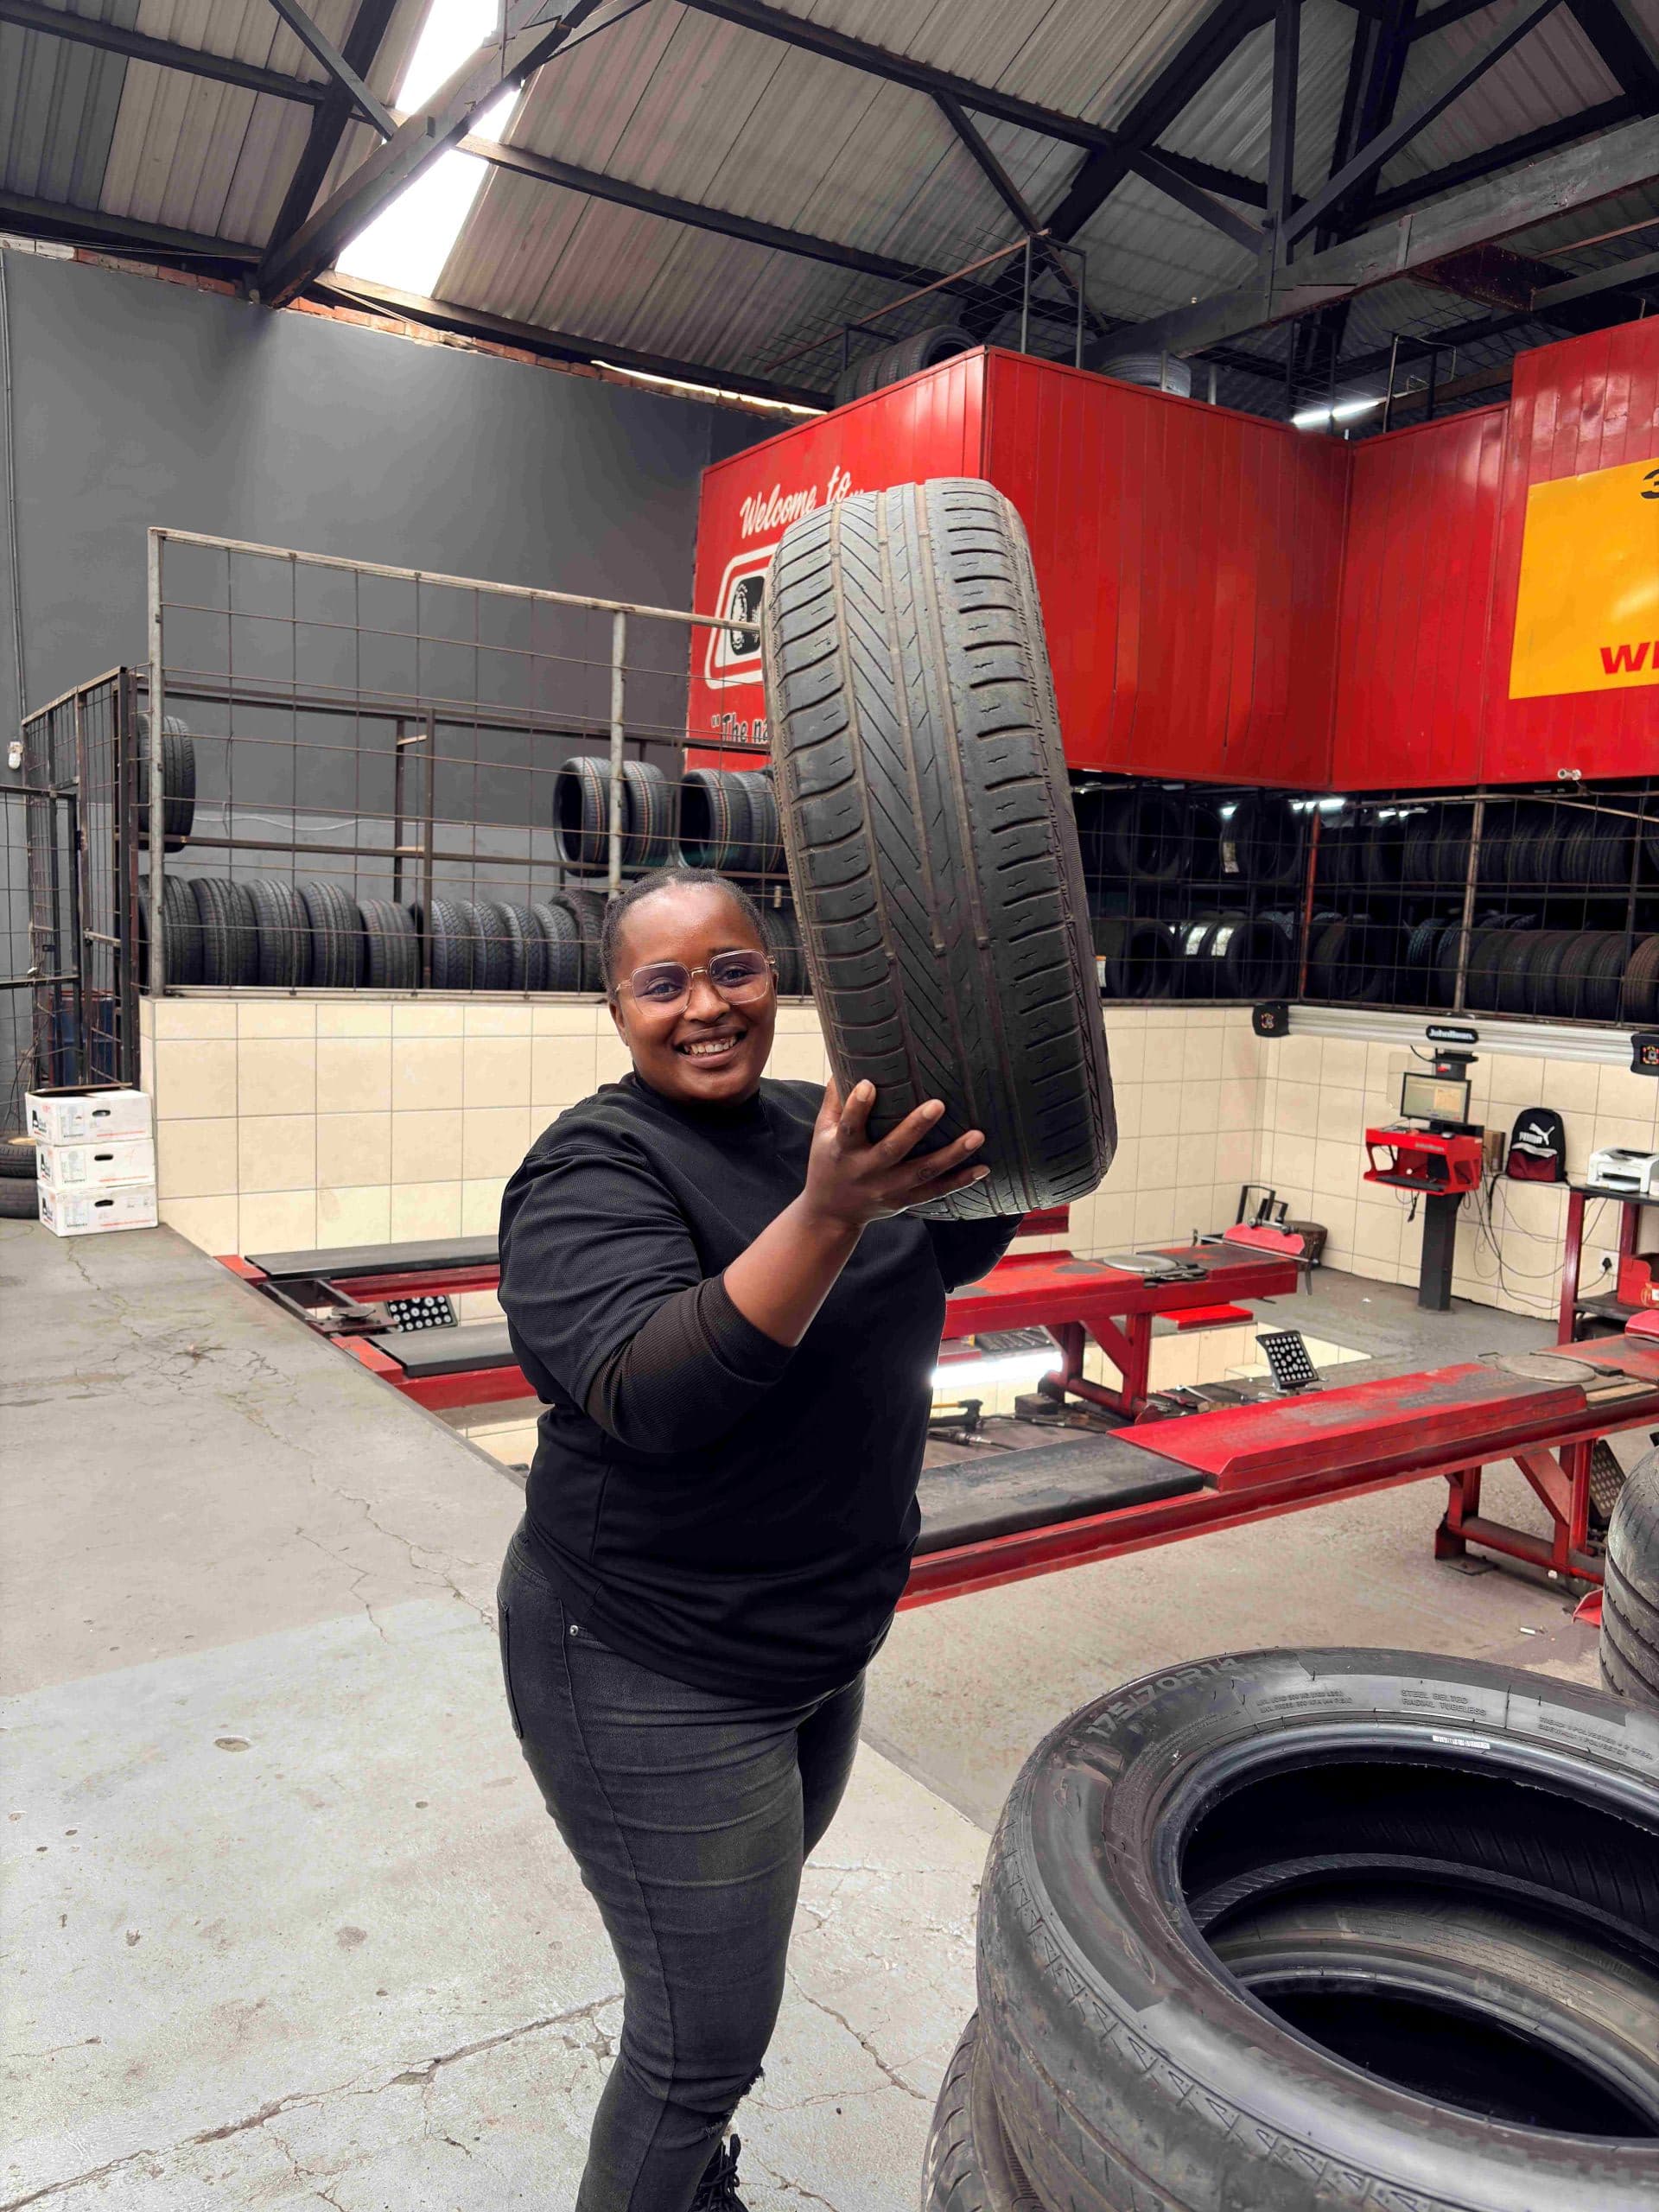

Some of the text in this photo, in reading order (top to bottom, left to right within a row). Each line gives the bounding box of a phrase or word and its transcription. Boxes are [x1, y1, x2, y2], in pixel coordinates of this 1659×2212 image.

[740, 484, 817, 539] Welcome
[1402, 1690, 1469, 1705] STEEL BELTED
[1402, 1698, 1487, 1716] RADIAL TUBELESS
